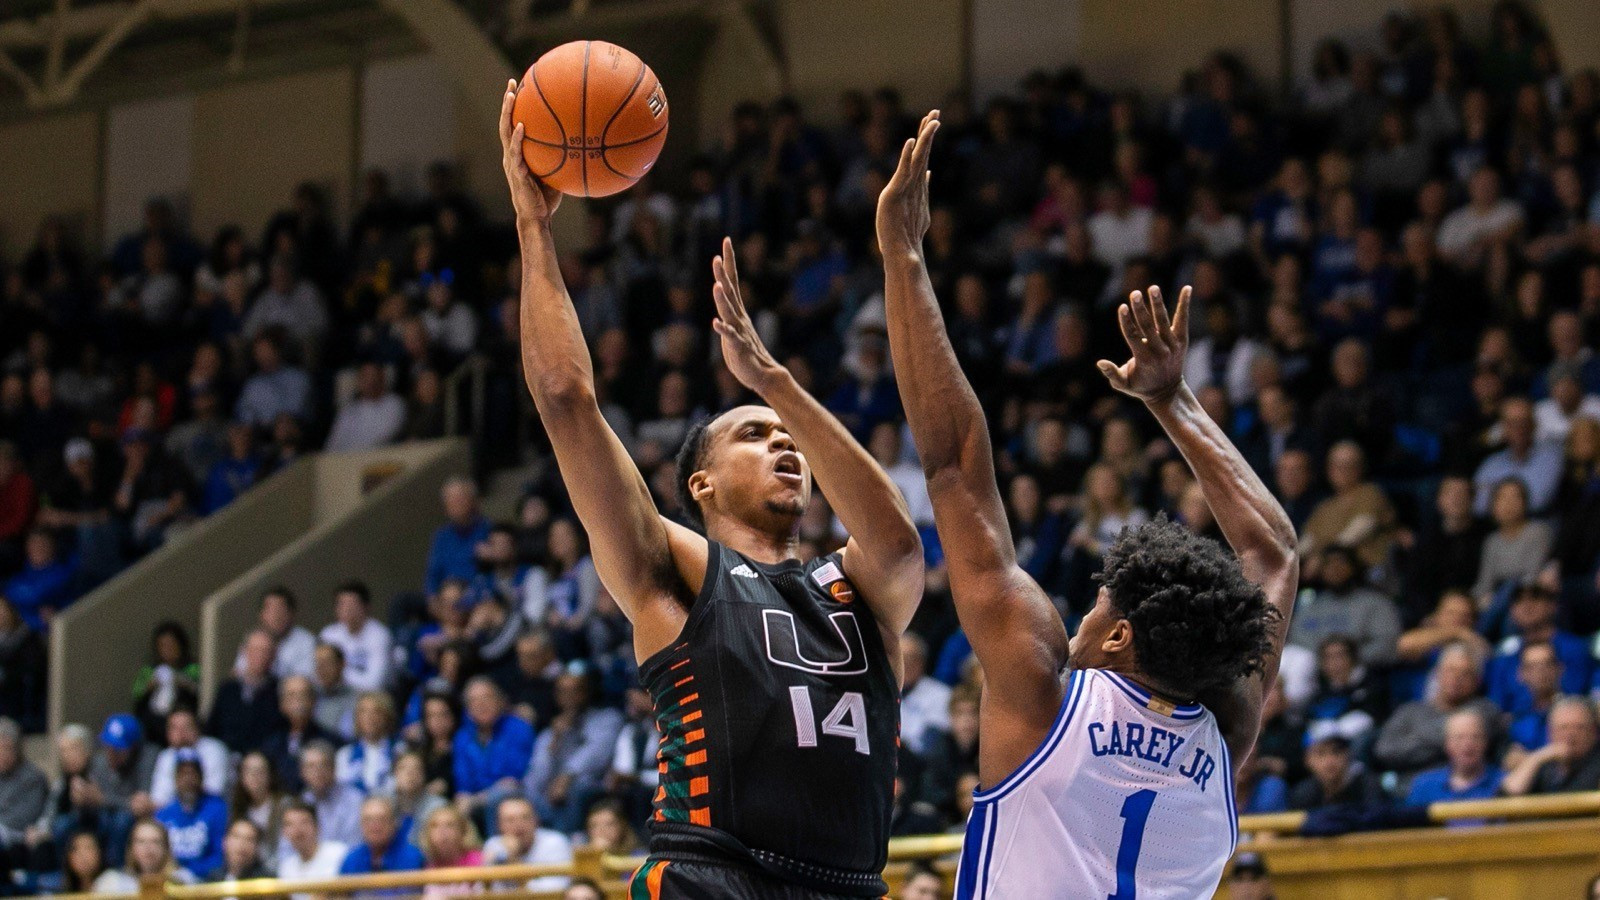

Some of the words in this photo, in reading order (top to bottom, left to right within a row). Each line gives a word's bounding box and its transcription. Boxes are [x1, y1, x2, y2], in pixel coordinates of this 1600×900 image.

[762, 609, 868, 675] U
[788, 685, 870, 755] 14
[1088, 721, 1185, 768] CAREY
[1179, 747, 1216, 792] JR
[1107, 788, 1158, 900] 1
